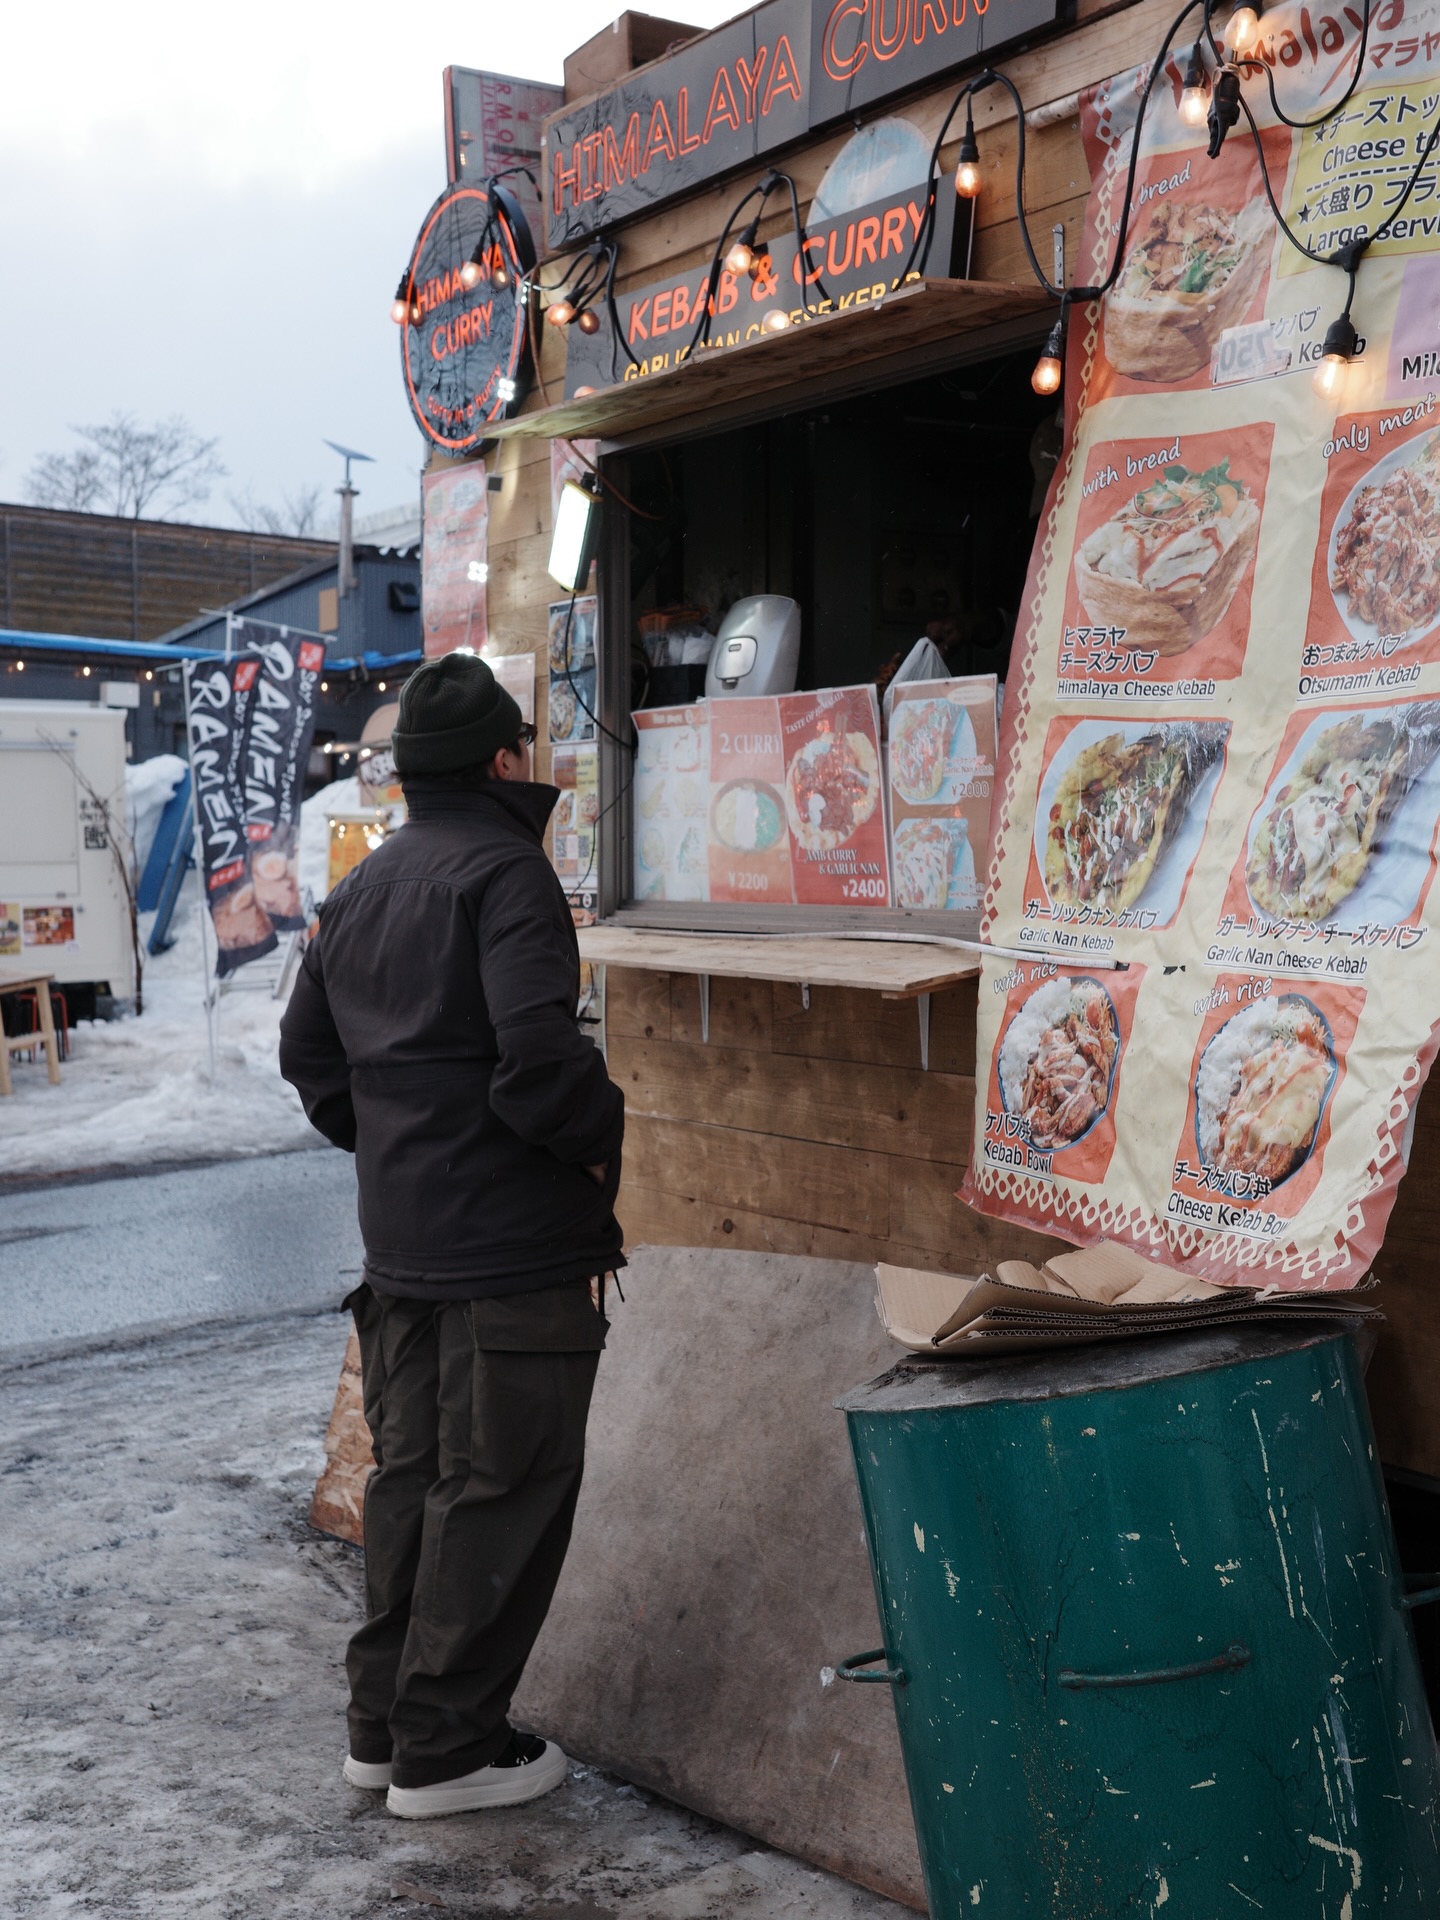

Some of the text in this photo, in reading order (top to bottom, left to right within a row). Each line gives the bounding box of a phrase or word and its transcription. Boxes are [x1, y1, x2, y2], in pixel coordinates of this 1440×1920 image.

[1164, 0, 1405, 110] Hmalaya
[552, 34, 802, 216] HIMALAYA
[1321, 137, 1406, 173] Cheese
[1138, 160, 1192, 206] bread
[1311, 175, 1440, 222] 大盛り プラ
[1306, 223, 1368, 254] Large
[415, 242, 505, 312] HIMAYA
[628, 194, 935, 345] KEBAB & CURRY
[431, 299, 494, 362] CURRY
[1298, 333, 1367, 364] Keb
[1322, 391, 1436, 459] only meat
[1081, 436, 1182, 499] with bread
[1063, 626, 1127, 647] ヒマラヤ
[1302, 632, 1406, 666] おつまみケバブ
[1060, 650, 1159, 673] チーズケバブ
[1298, 662, 1422, 695] Otsumami Kebab
[1057, 679, 1216, 697] Himalaya Cheese Kebab
[719, 732, 732, 754] 2
[785, 719, 809, 735] TASTE
[188, 670, 244, 870] RAMEN
[818, 862, 880, 875] & GARLIC NAN
[827, 849, 858, 861] CURRY
[842, 878, 886, 898] ¥2400
[1024, 900, 1160, 930] ガーリックナンケバブ
[1019, 926, 1115, 951] Garlic Nan Kebab
[1206, 944, 1368, 974] Garlic Nan Cheese Kebab
[993, 961, 1059, 995] with rice
[1193, 975, 1274, 1016] with rice
[985, 1110, 1031, 1139] ケバブ丼
[984, 1138, 1053, 1175] Kebab Bowl
[1174, 1161, 1272, 1200] チーズケバブ丼
[1167, 1192, 1213, 1222] Cheese
[1217, 1204, 1262, 1232] Kebab
